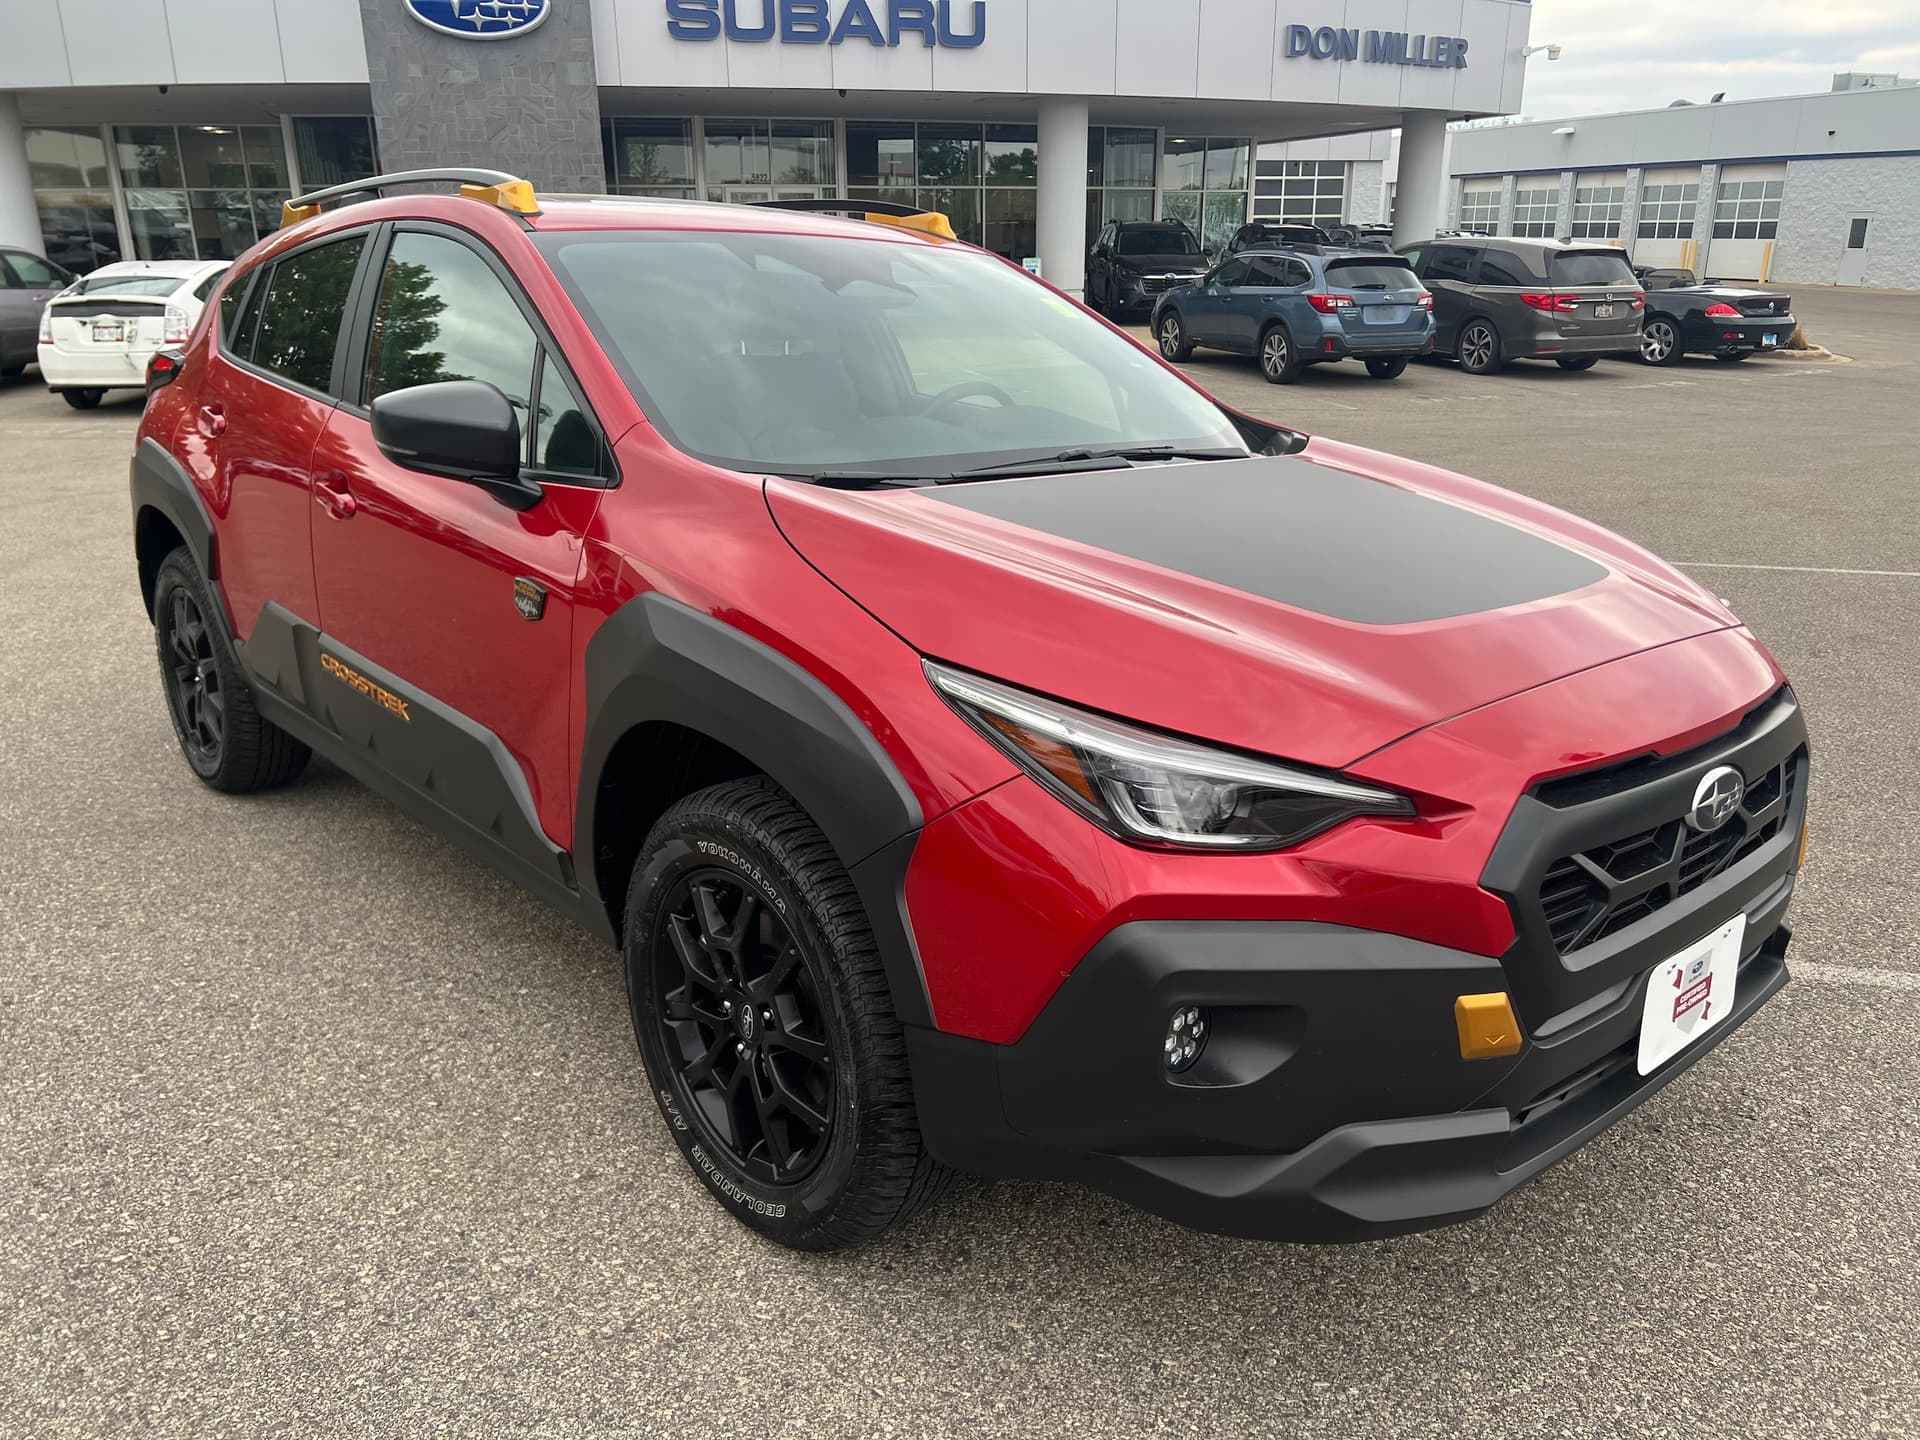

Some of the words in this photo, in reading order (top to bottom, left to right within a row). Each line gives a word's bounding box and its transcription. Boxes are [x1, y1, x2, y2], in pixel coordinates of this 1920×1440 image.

[666, 0, 986, 48] SUBARU
[1285, 24, 1360, 61] DON
[1364, 30, 1469, 69] MILLER
[320, 653, 410, 721] CROSSTREK
[697, 841, 786, 914] YOKOHAMA
[660, 1090, 688, 1130] A/T
[691, 1144, 786, 1218] GEOLANDAR
